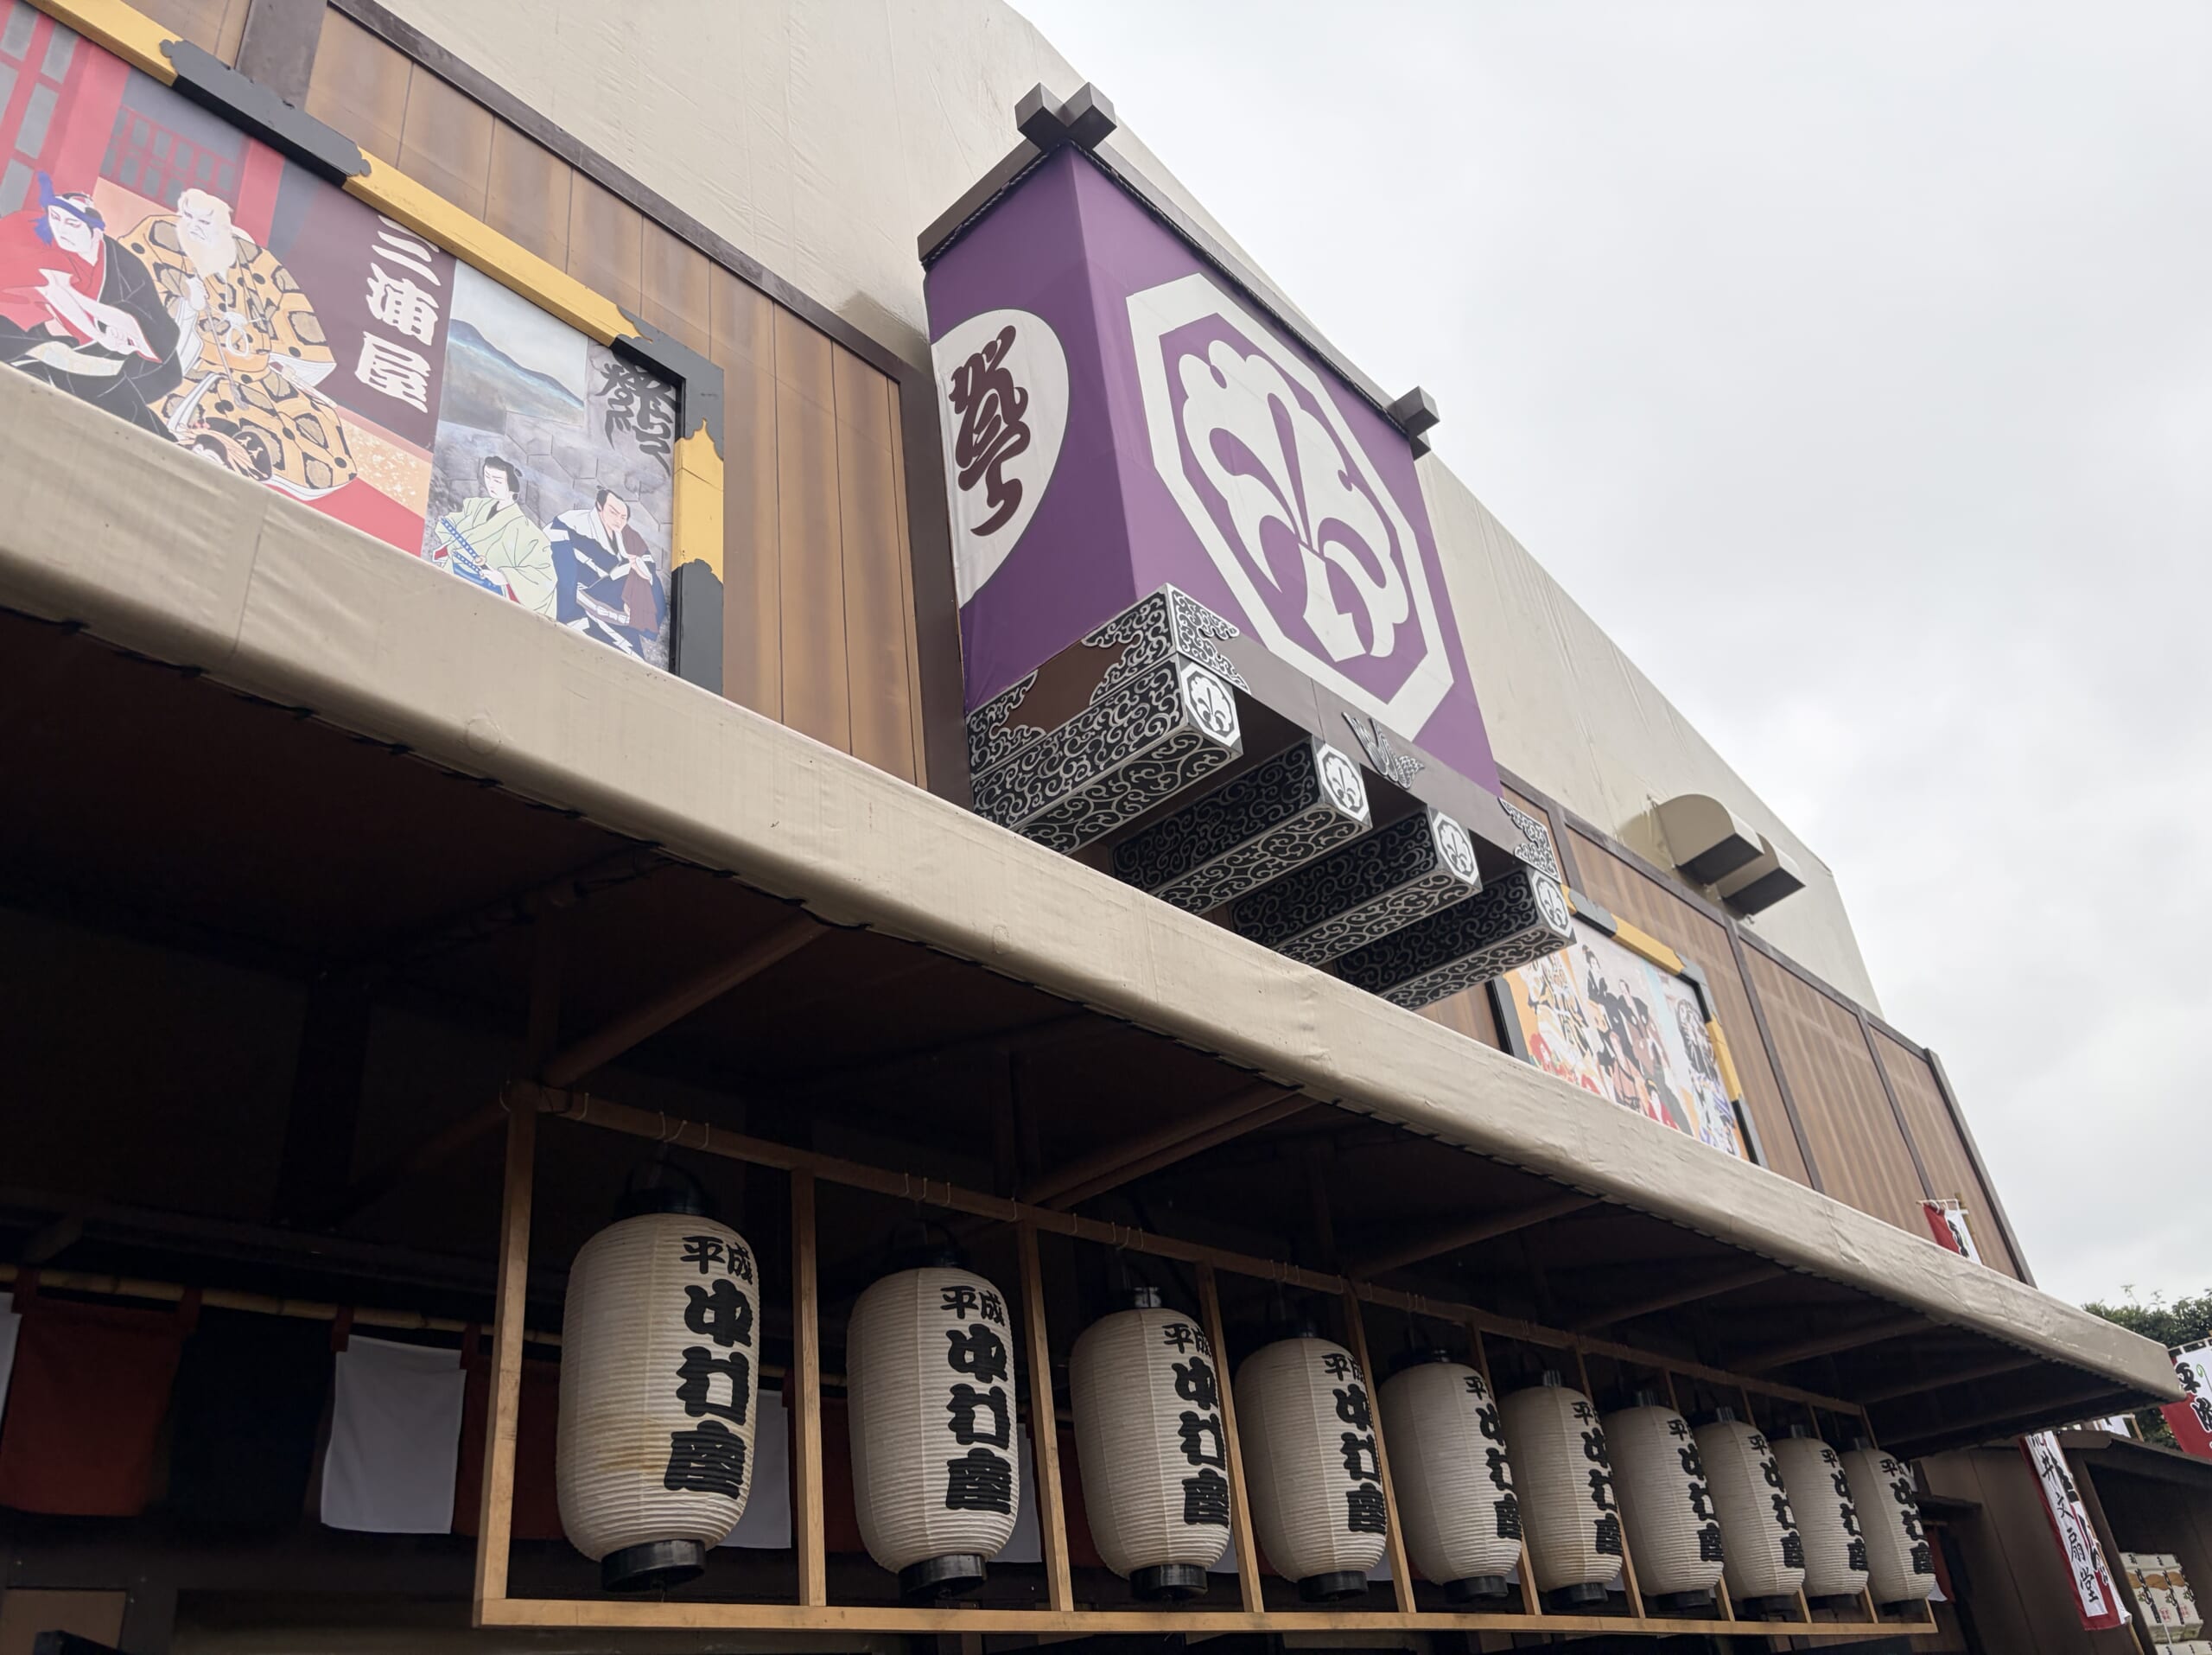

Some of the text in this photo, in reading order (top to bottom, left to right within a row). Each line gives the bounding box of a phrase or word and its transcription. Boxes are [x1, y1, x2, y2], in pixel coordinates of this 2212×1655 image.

[355, 214, 442, 414] 三浦屋
[680, 1235, 753, 1285] 平成
[940, 1285, 1005, 1326] 平成
[664, 1279, 754, 1500] 中村座
[945, 1324, 1013, 1515] 中村座
